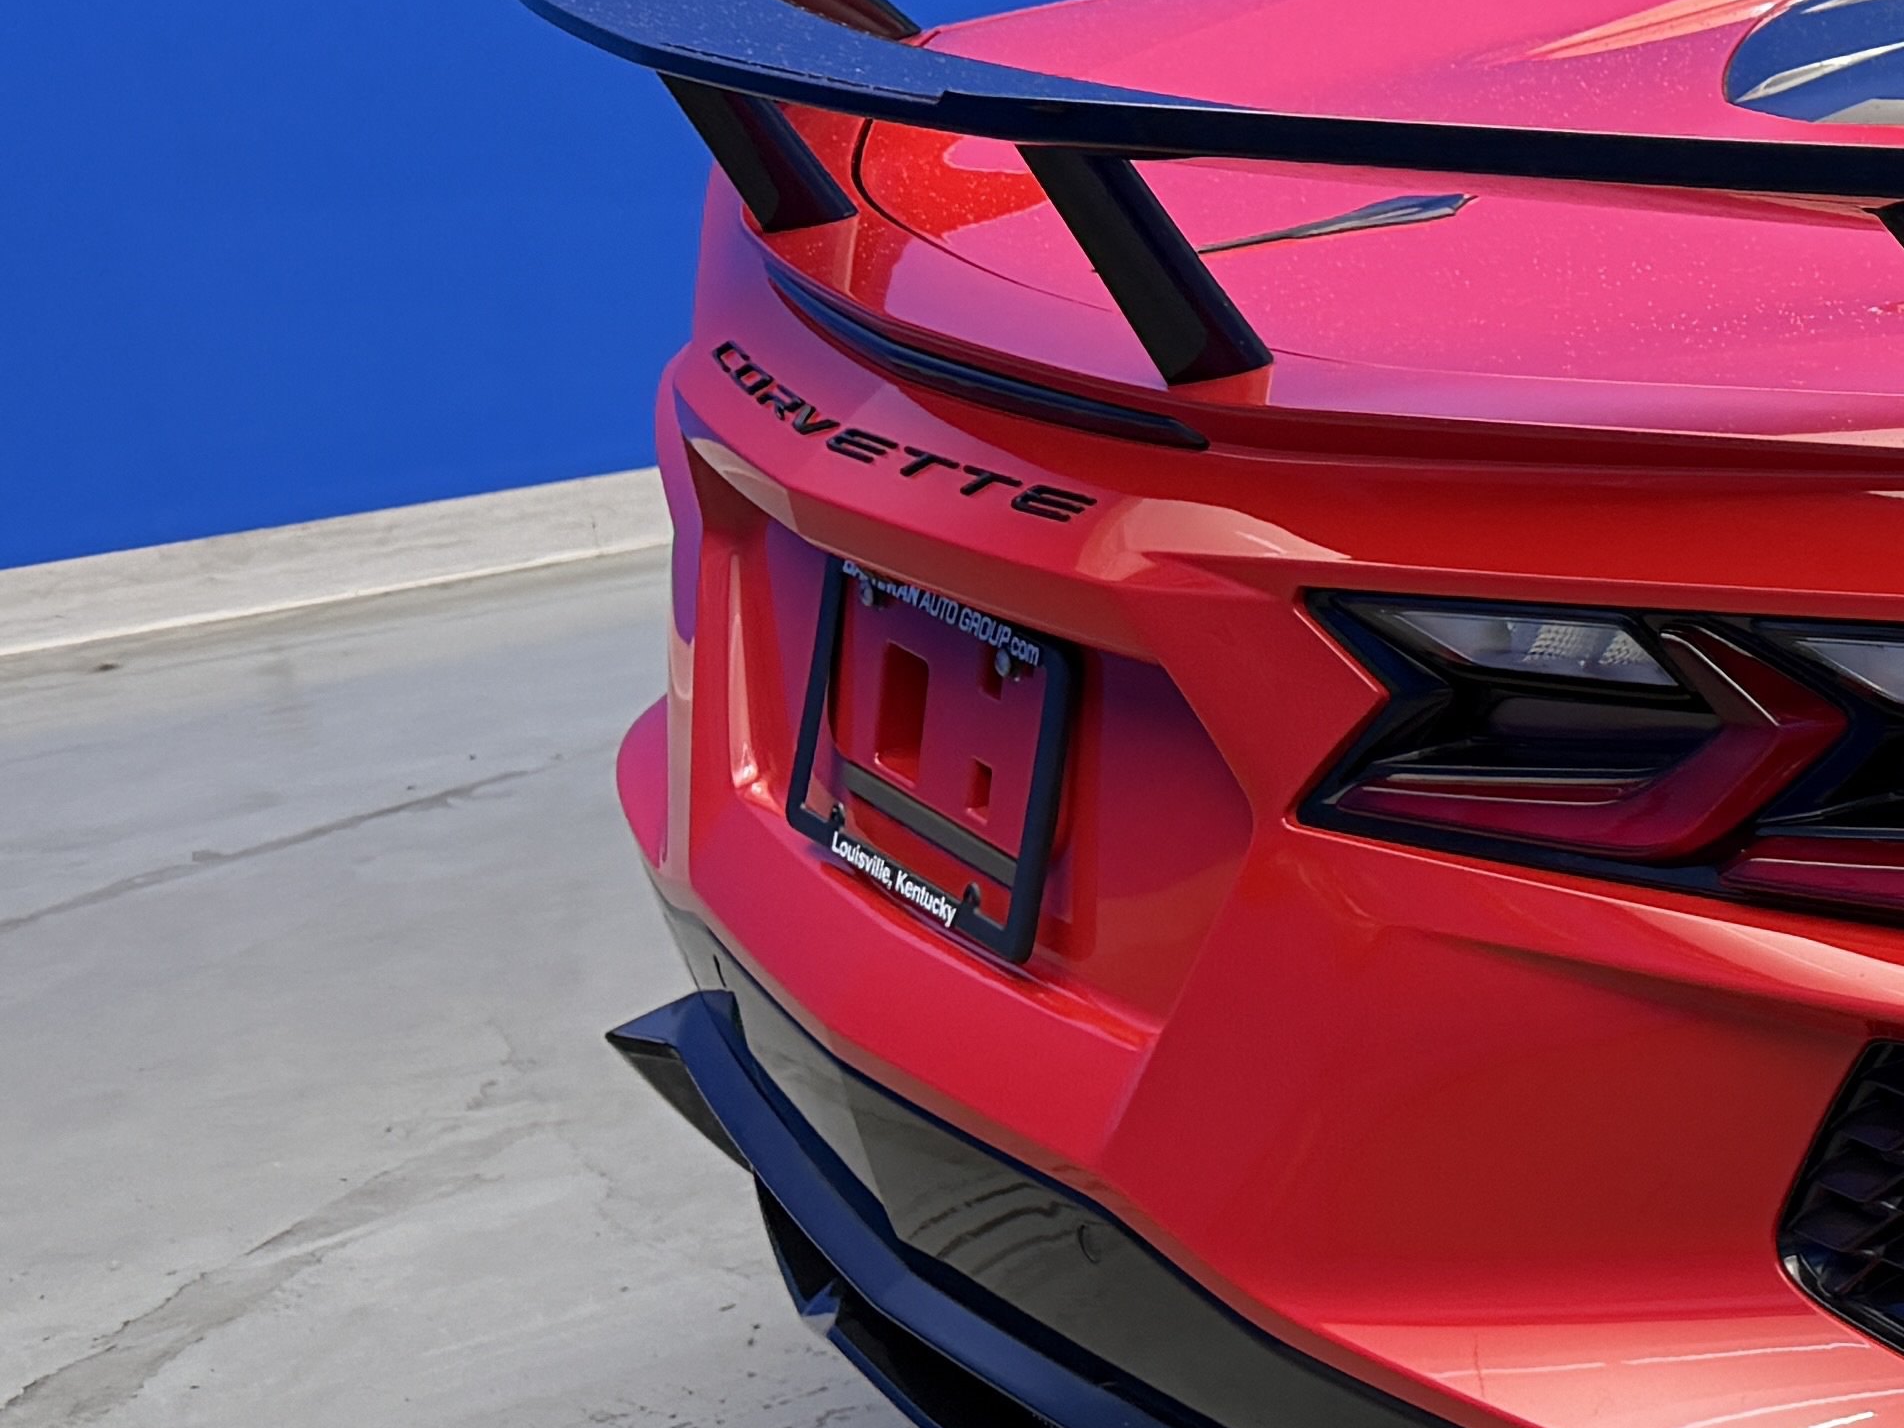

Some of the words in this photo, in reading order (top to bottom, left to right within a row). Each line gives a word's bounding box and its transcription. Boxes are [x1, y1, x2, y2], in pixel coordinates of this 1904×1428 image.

[712, 340, 1098, 523] CORVETTE
[918, 592, 959, 625] AUTO
[959, 608, 1040, 666] GROUP.com
[831, 830, 893, 890] Louisville,
[895, 870, 957, 928] Kentucky
